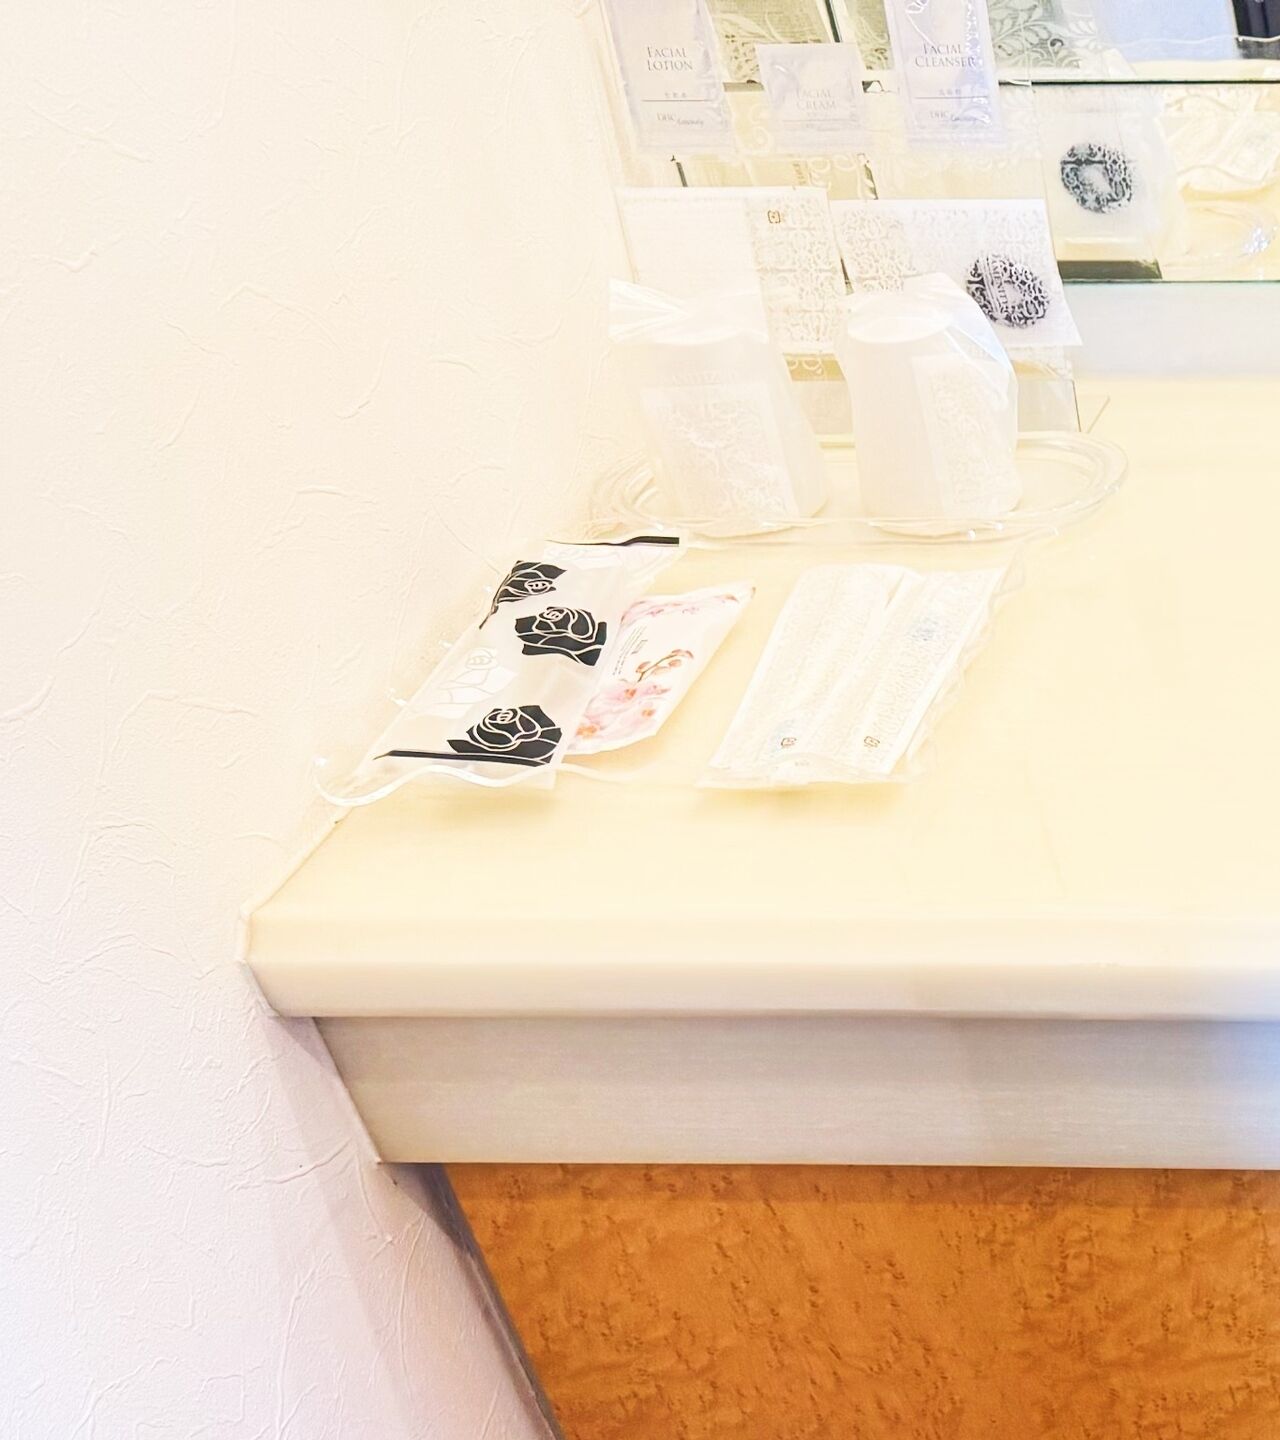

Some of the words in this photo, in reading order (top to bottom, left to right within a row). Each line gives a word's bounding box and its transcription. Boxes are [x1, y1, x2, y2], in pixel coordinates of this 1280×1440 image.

[647, 46, 687, 58] FACIAL
[922, 43, 962, 55] FACIAL
[647, 60, 694, 72] LOTION
[914, 56, 977, 68] CLEANSER
